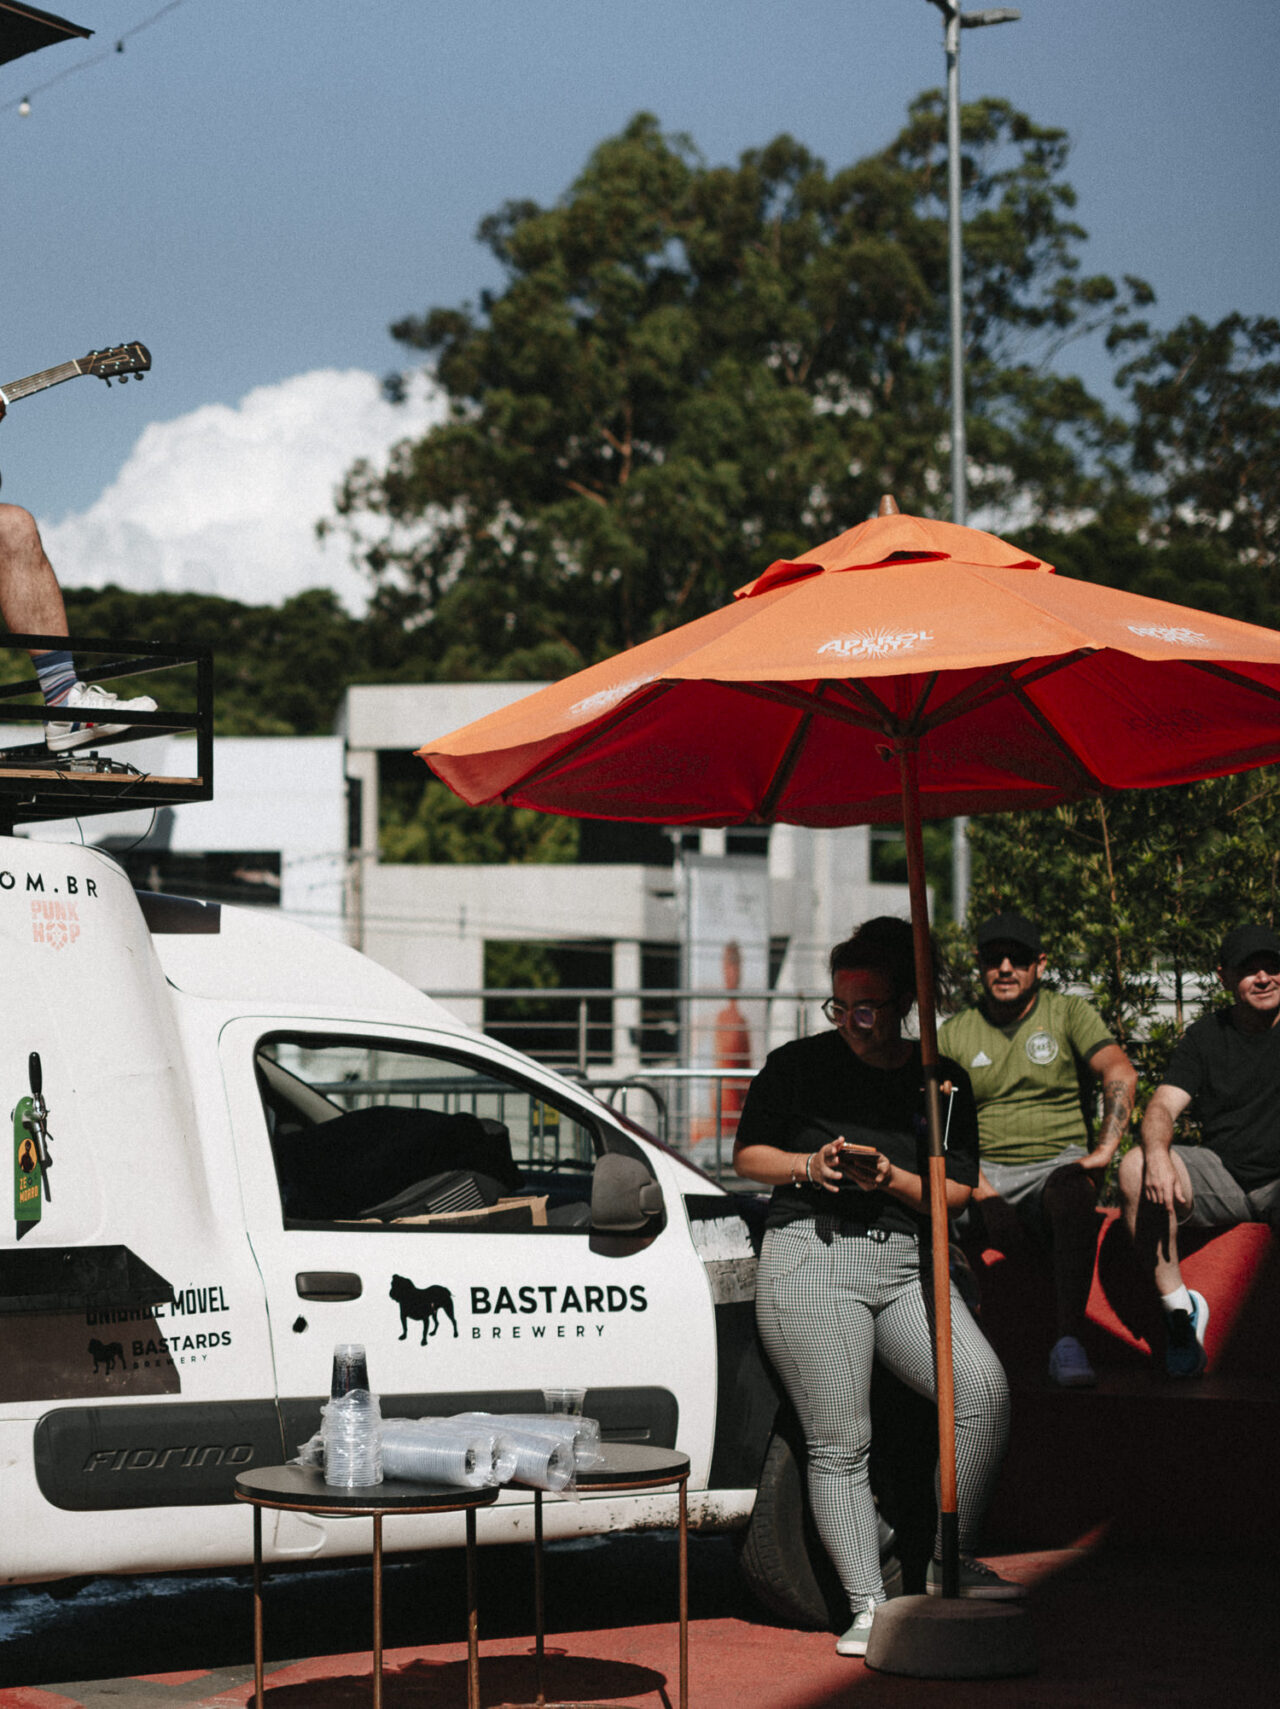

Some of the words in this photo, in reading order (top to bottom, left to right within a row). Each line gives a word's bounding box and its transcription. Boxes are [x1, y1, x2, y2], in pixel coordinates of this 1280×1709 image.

[817, 630, 934, 654] APEROL
[30, 899, 80, 923] PUNK
[171, 1282, 230, 1317] MÓVEL
[470, 1285, 648, 1315] BASTARDS
[131, 1331, 232, 1357] BASTARDS
[471, 1325, 605, 1339] BREWERY
[132, 1354, 208, 1370] BREWERY
